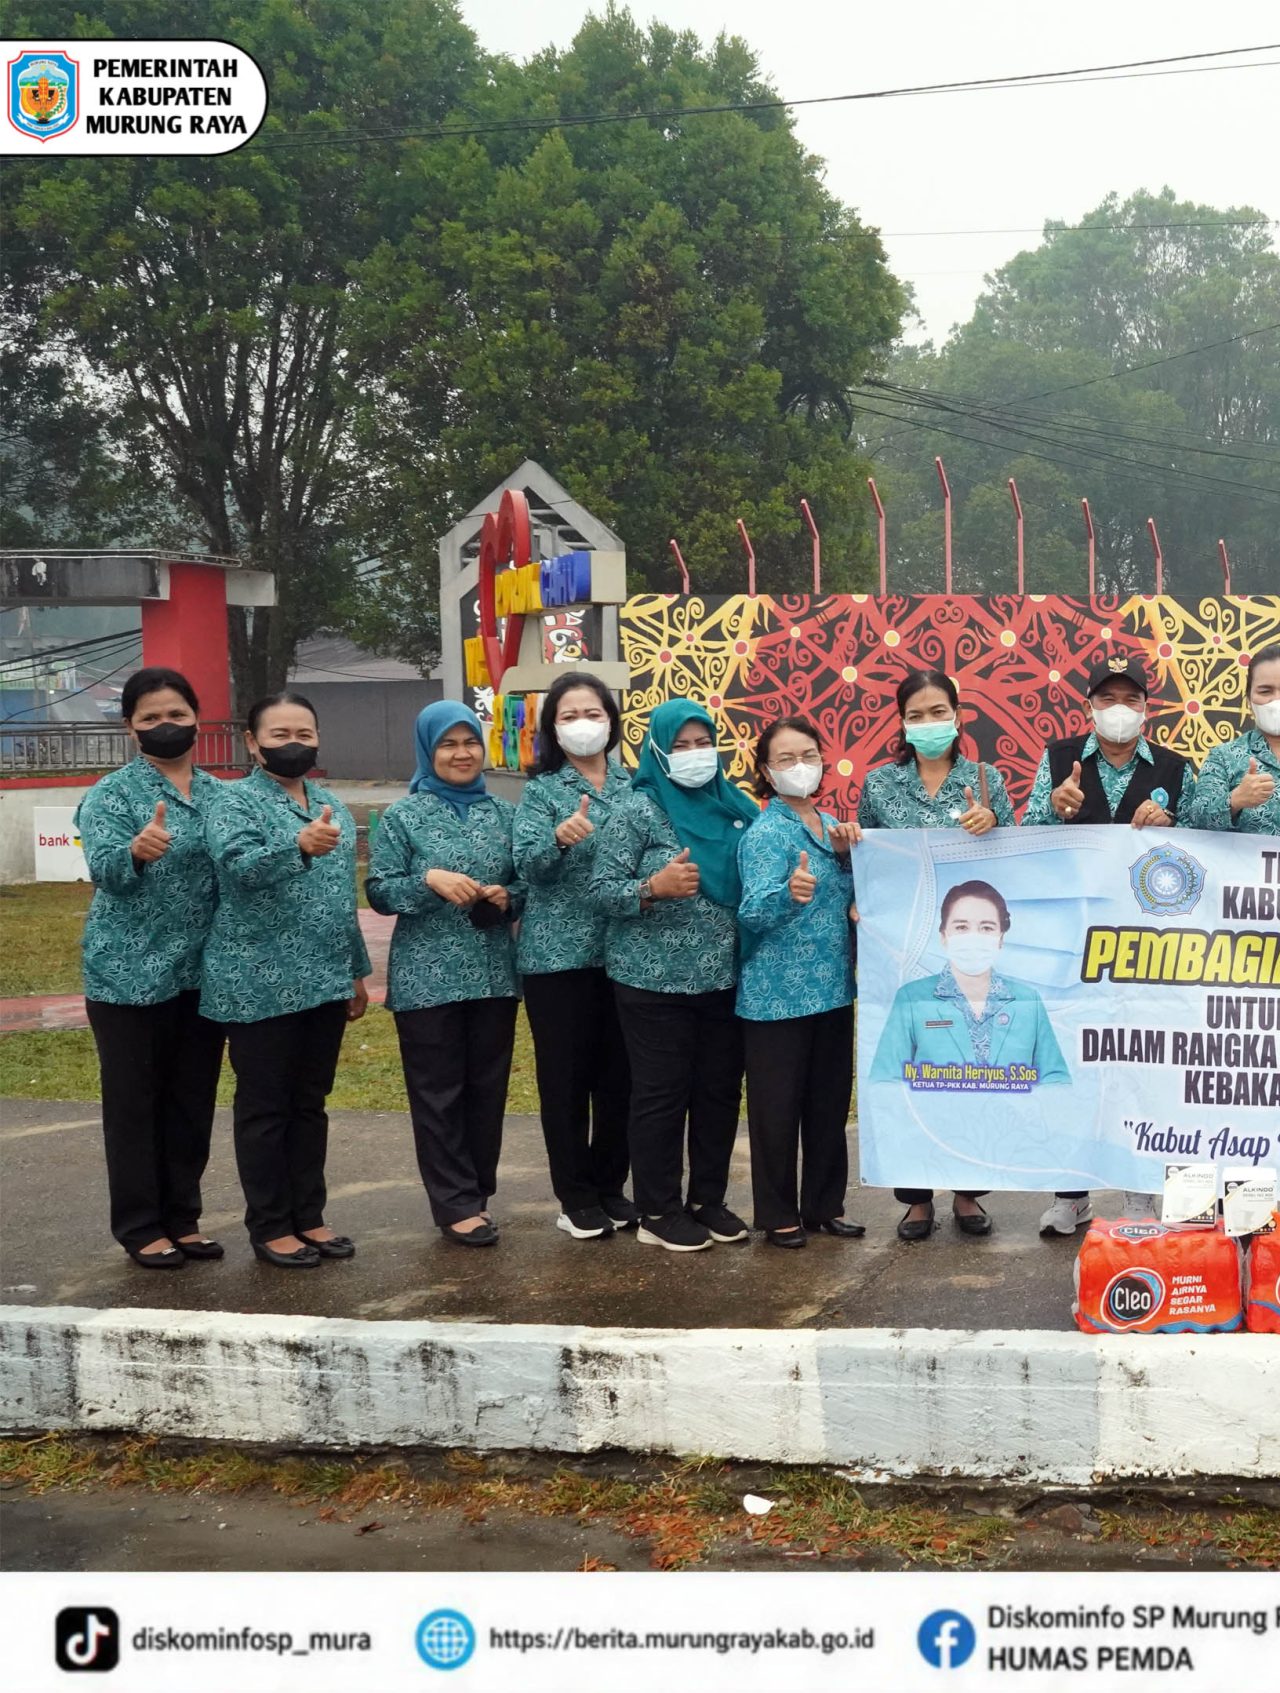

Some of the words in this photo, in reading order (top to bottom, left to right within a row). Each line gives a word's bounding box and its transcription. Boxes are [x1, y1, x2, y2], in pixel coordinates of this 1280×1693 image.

[39, 833, 70, 847] bank
[1082, 1028, 1165, 1064] DALAM
[1171, 1031, 1278, 1069] RANGKA
[904, 1063, 919, 1081] Ny.
[922, 1064, 963, 1080] Warnita
[965, 1065, 1008, 1083] Heriyus,
[1009, 1065, 1037, 1081] S.Sos
[913, 1081, 934, 1089] KETUA
[979, 1082, 1009, 1090] MURUNG
[1208, 1127, 1270, 1166] Asap
[1124, 1227, 1158, 1235] Cleo
[1172, 1275, 1202, 1285] MURNI
[1171, 1285, 1207, 1295] AIRNYA
[1114, 1287, 1151, 1310] Cleo
[1170, 1295, 1203, 1305] SEGAR
[1169, 1305, 1216, 1315] RASANYA
